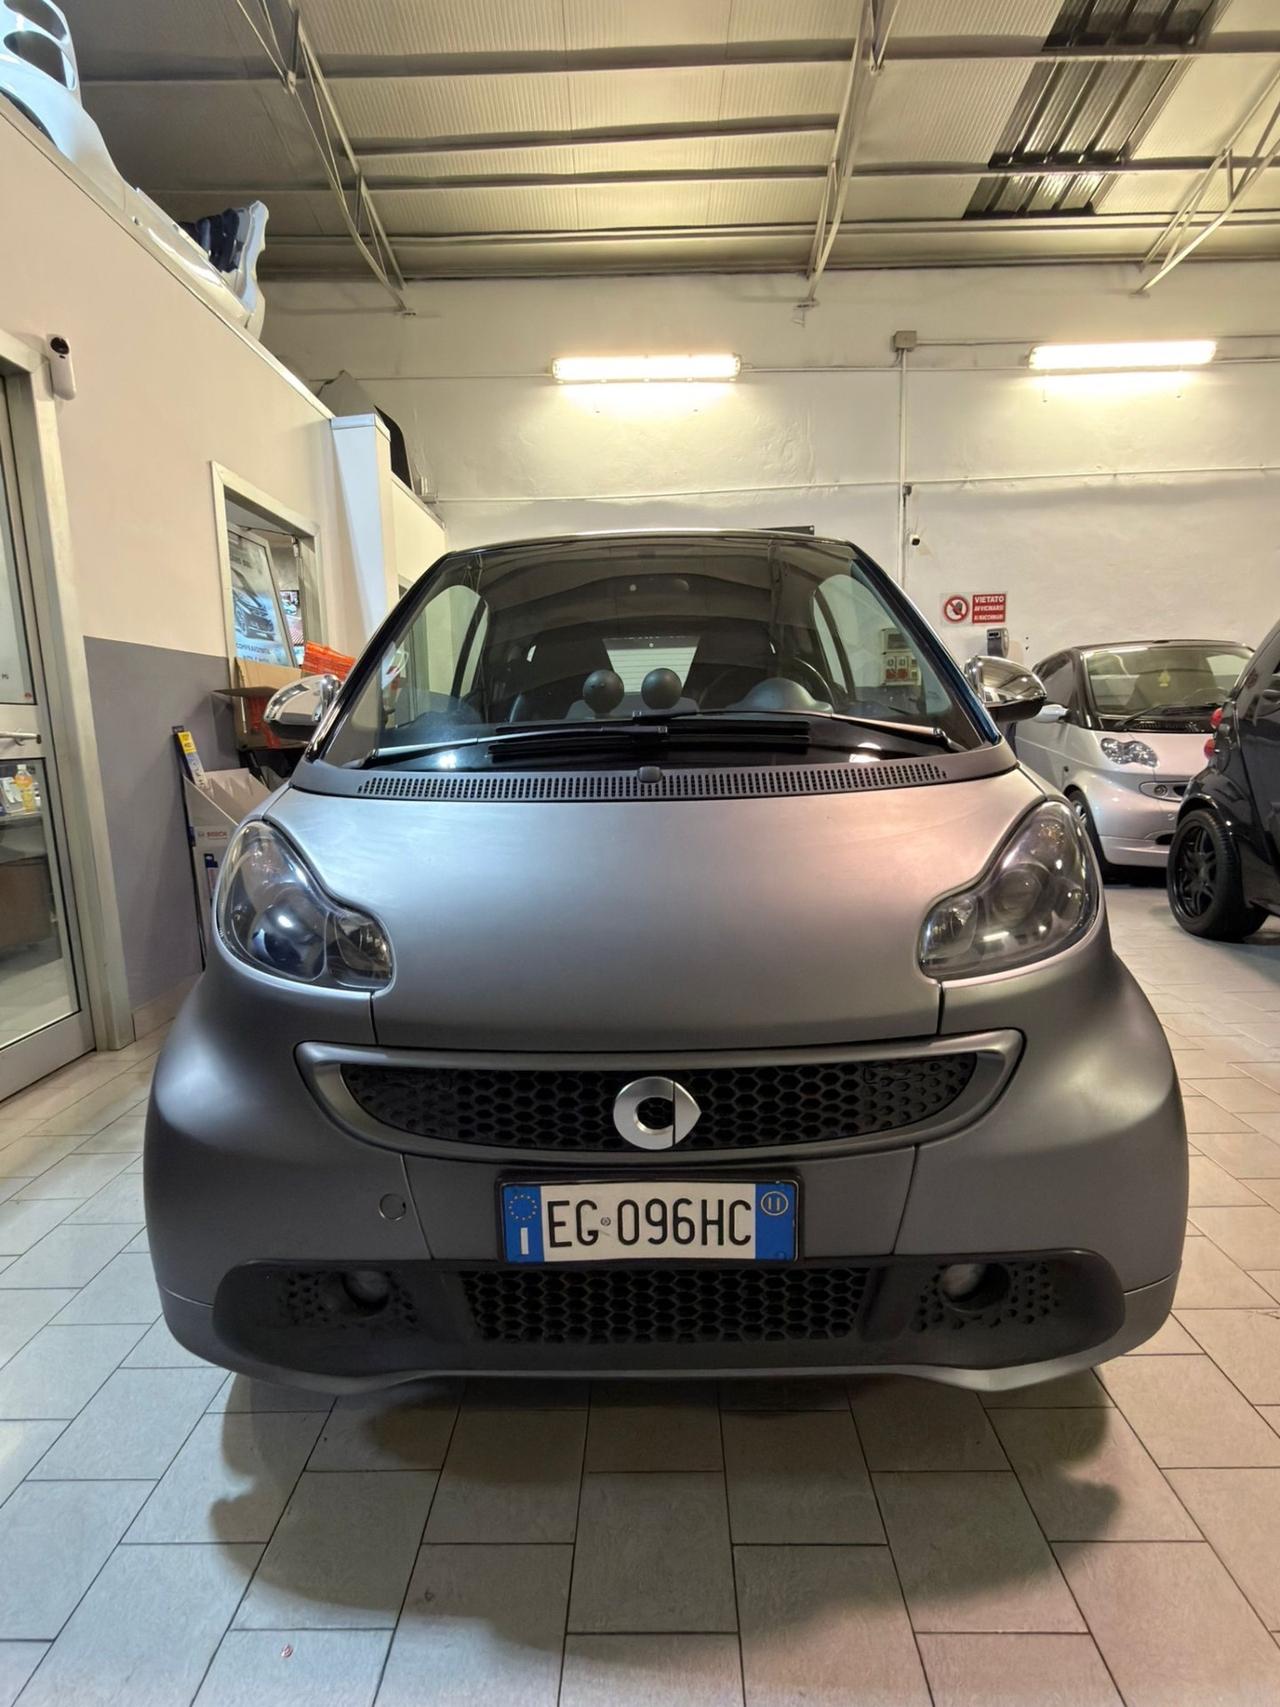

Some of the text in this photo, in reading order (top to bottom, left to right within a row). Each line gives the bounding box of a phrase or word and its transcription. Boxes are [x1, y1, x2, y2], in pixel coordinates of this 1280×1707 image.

[520, 1227, 529, 1255] I
[547, 1198, 752, 1249] EG 096HC
